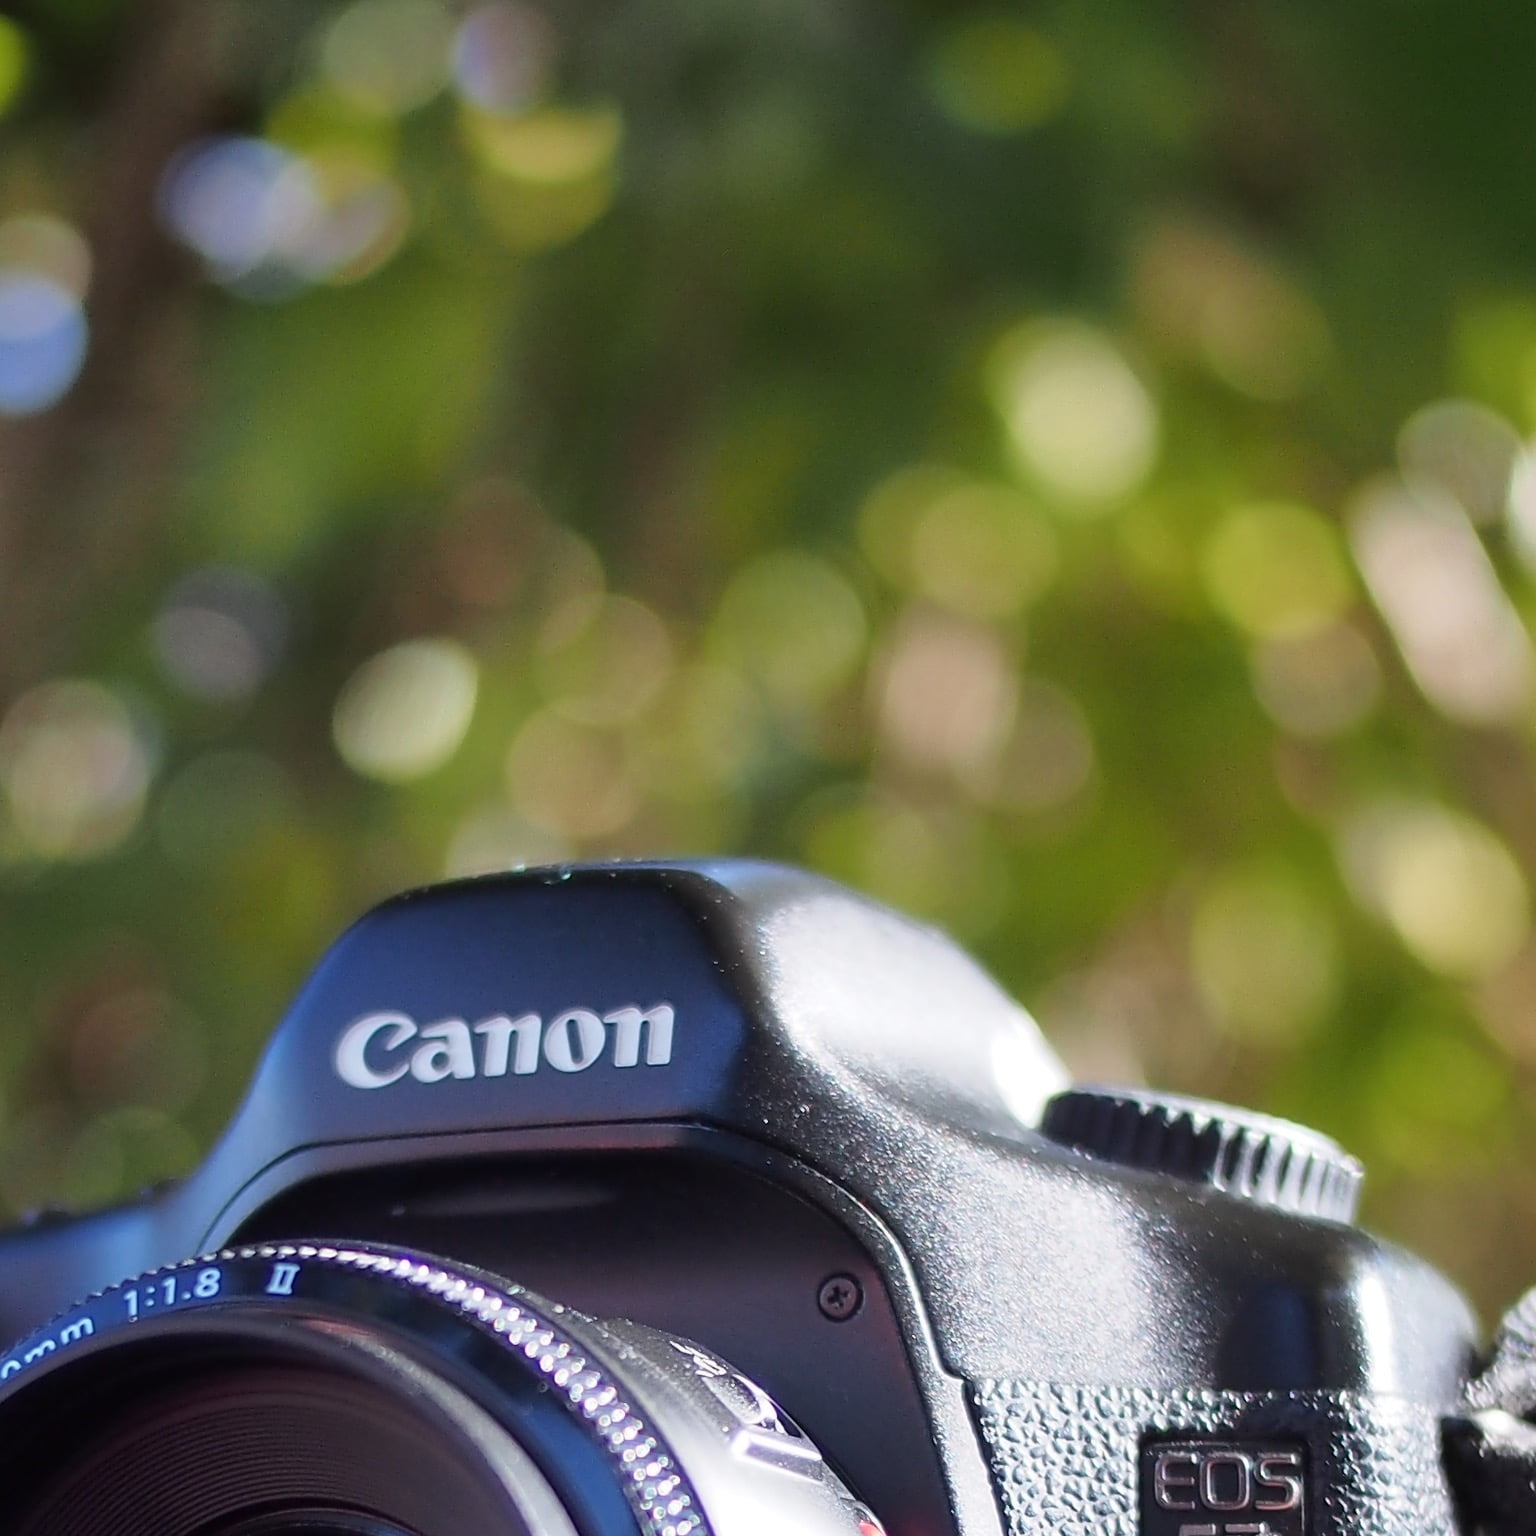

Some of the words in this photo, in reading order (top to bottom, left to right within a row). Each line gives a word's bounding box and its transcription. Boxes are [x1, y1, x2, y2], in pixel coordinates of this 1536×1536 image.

[333, 1002, 676, 1089] Canon
[122, 1266, 223, 1318] 1:1.8
[1152, 1450, 1304, 1511] EOS
